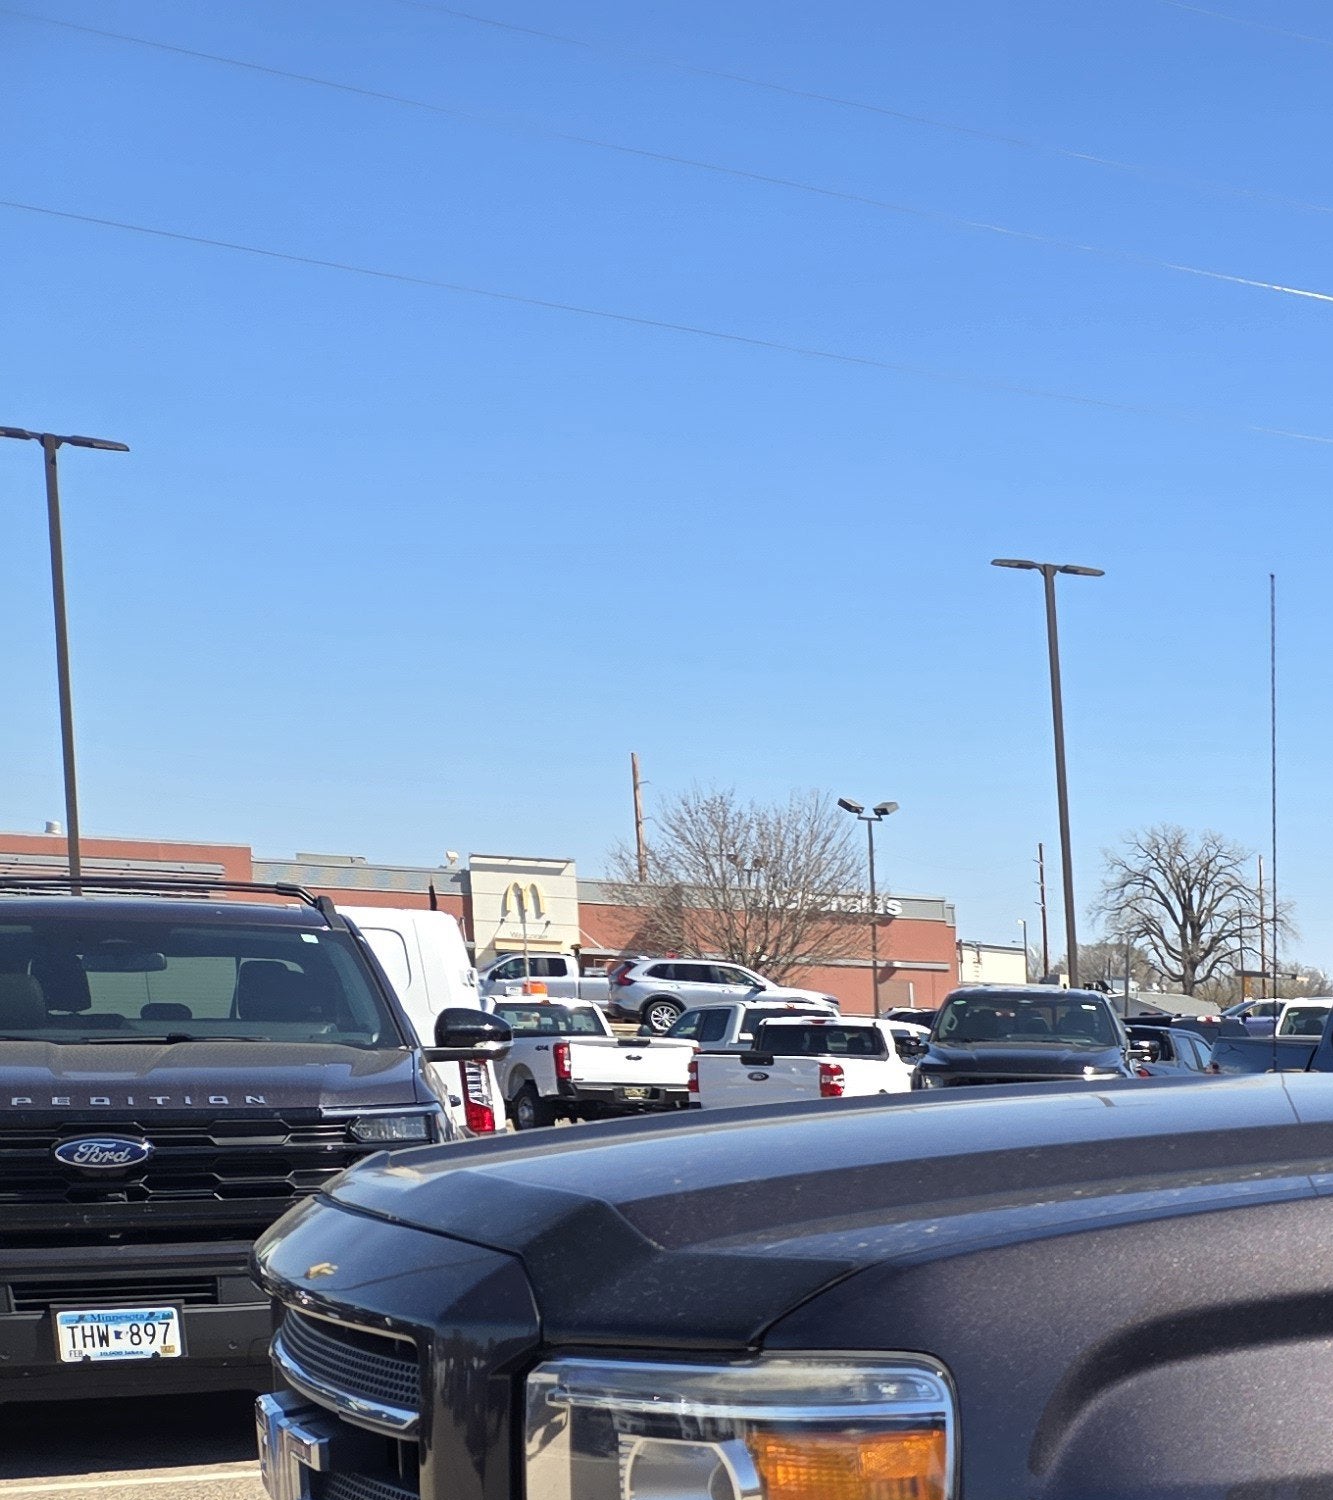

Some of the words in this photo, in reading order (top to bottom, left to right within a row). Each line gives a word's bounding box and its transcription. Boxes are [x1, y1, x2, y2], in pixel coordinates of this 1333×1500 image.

[74, 1141, 131, 1164] Ford
[90, 1312, 145, 1323] Minnesota
[66, 1324, 110, 1349] THW
[129, 1321, 170, 1346] 897
